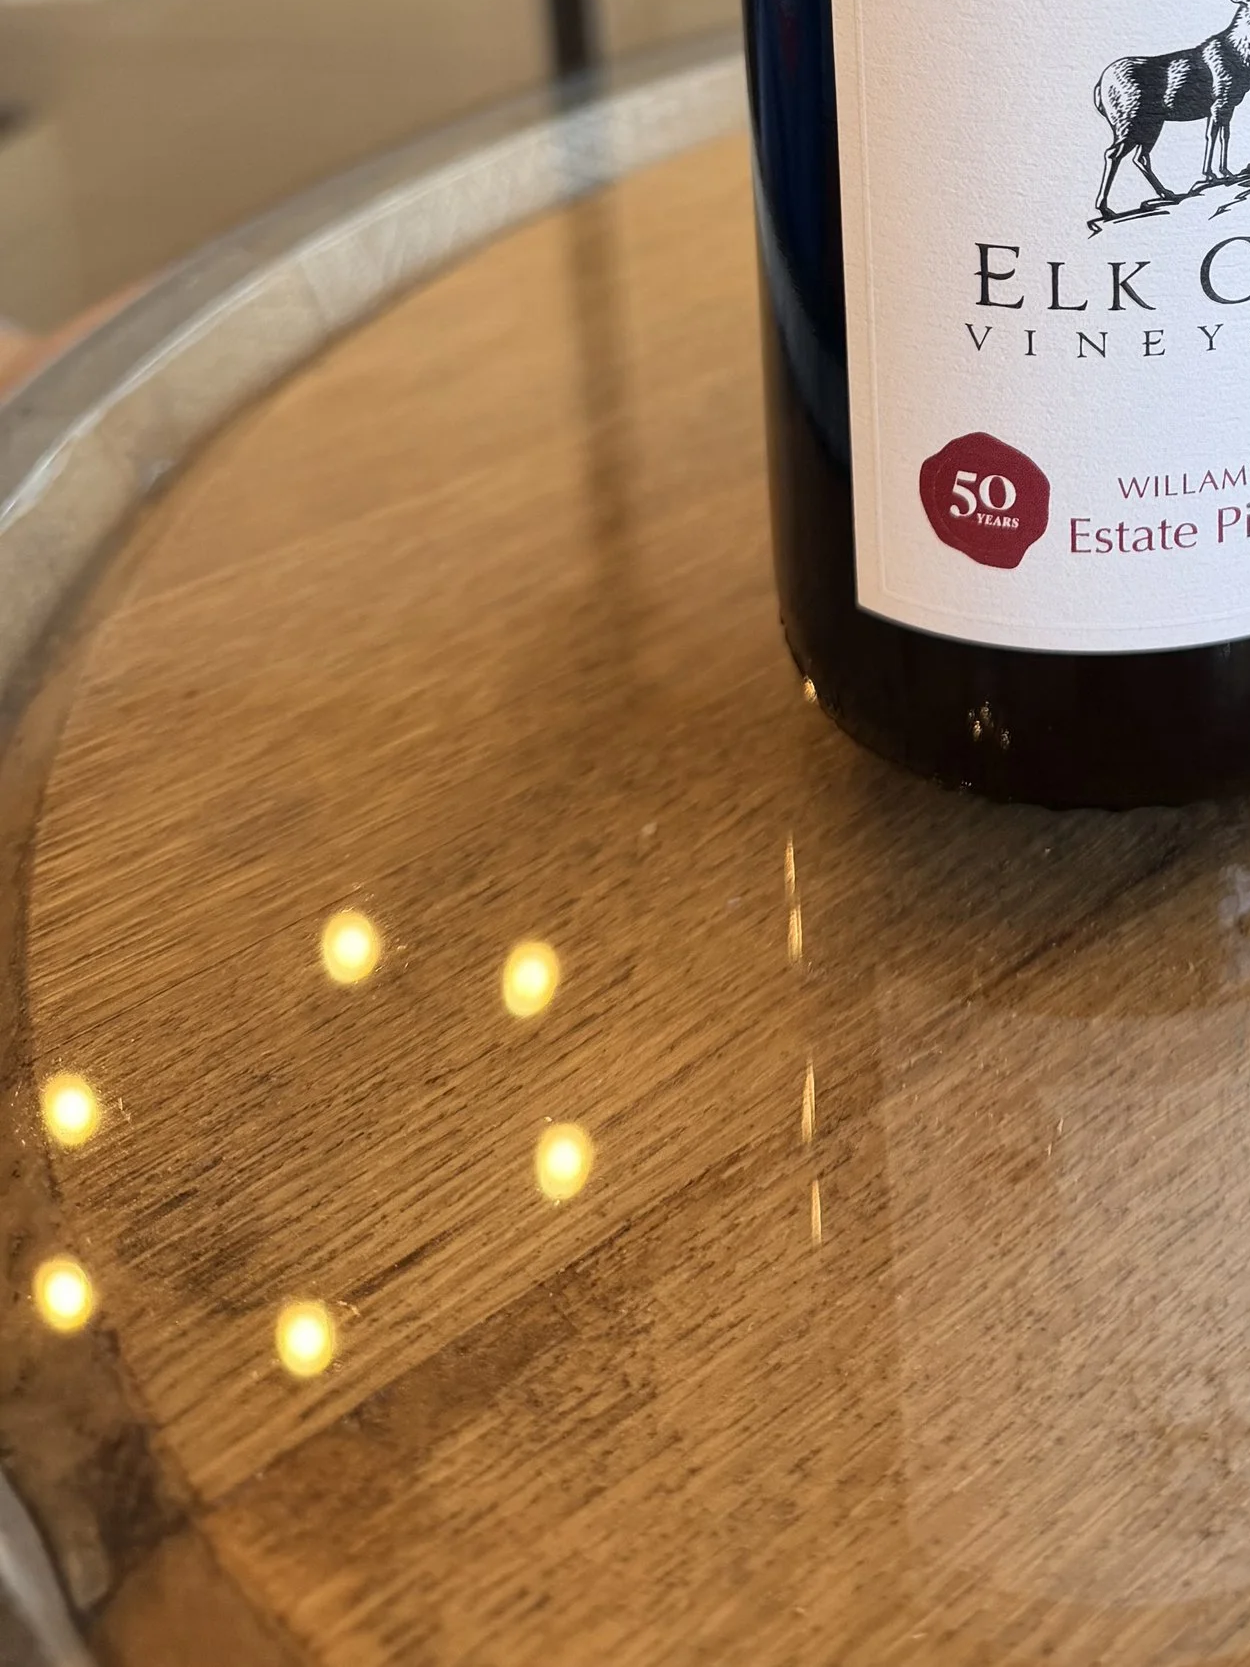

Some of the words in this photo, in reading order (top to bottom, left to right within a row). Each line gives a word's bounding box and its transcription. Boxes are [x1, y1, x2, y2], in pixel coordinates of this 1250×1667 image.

[974, 242, 1156, 312] ELK
[948, 471, 1017, 517] 50
[976, 513, 1020, 528] YEARS
[1070, 517, 1197, 554] Estate
